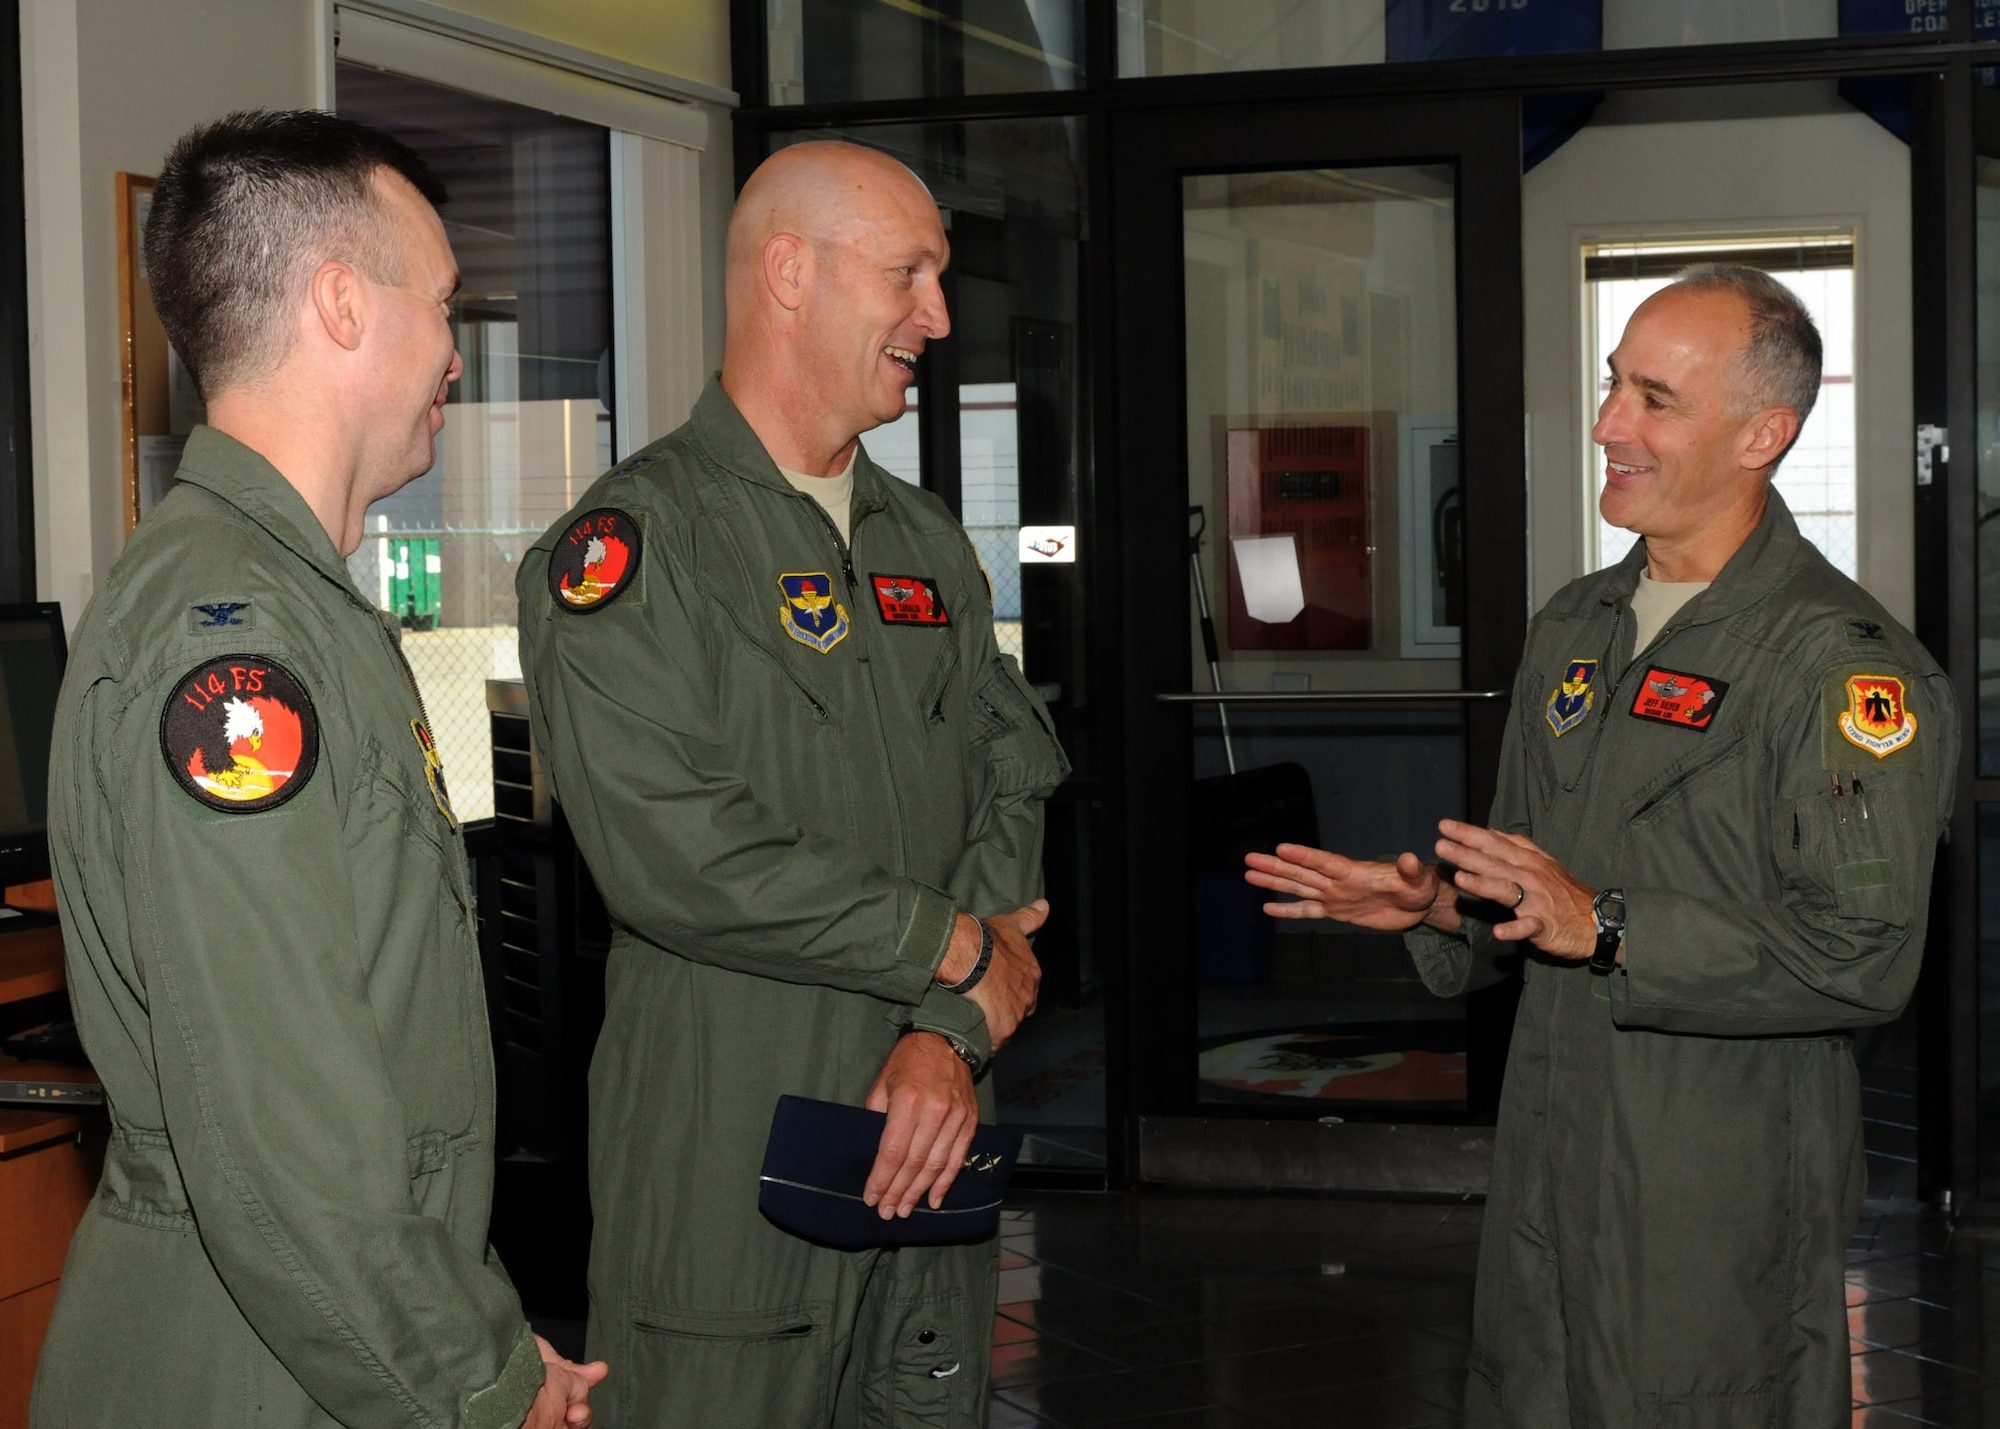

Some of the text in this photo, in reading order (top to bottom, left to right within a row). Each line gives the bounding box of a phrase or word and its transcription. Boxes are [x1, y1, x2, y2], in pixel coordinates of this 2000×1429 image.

[568, 517, 617, 546] 114 FS
[184, 666, 265, 711] 114 FS
[1866, 738, 1894, 749] FIGHTER
[1896, 728, 1911, 742] WING
